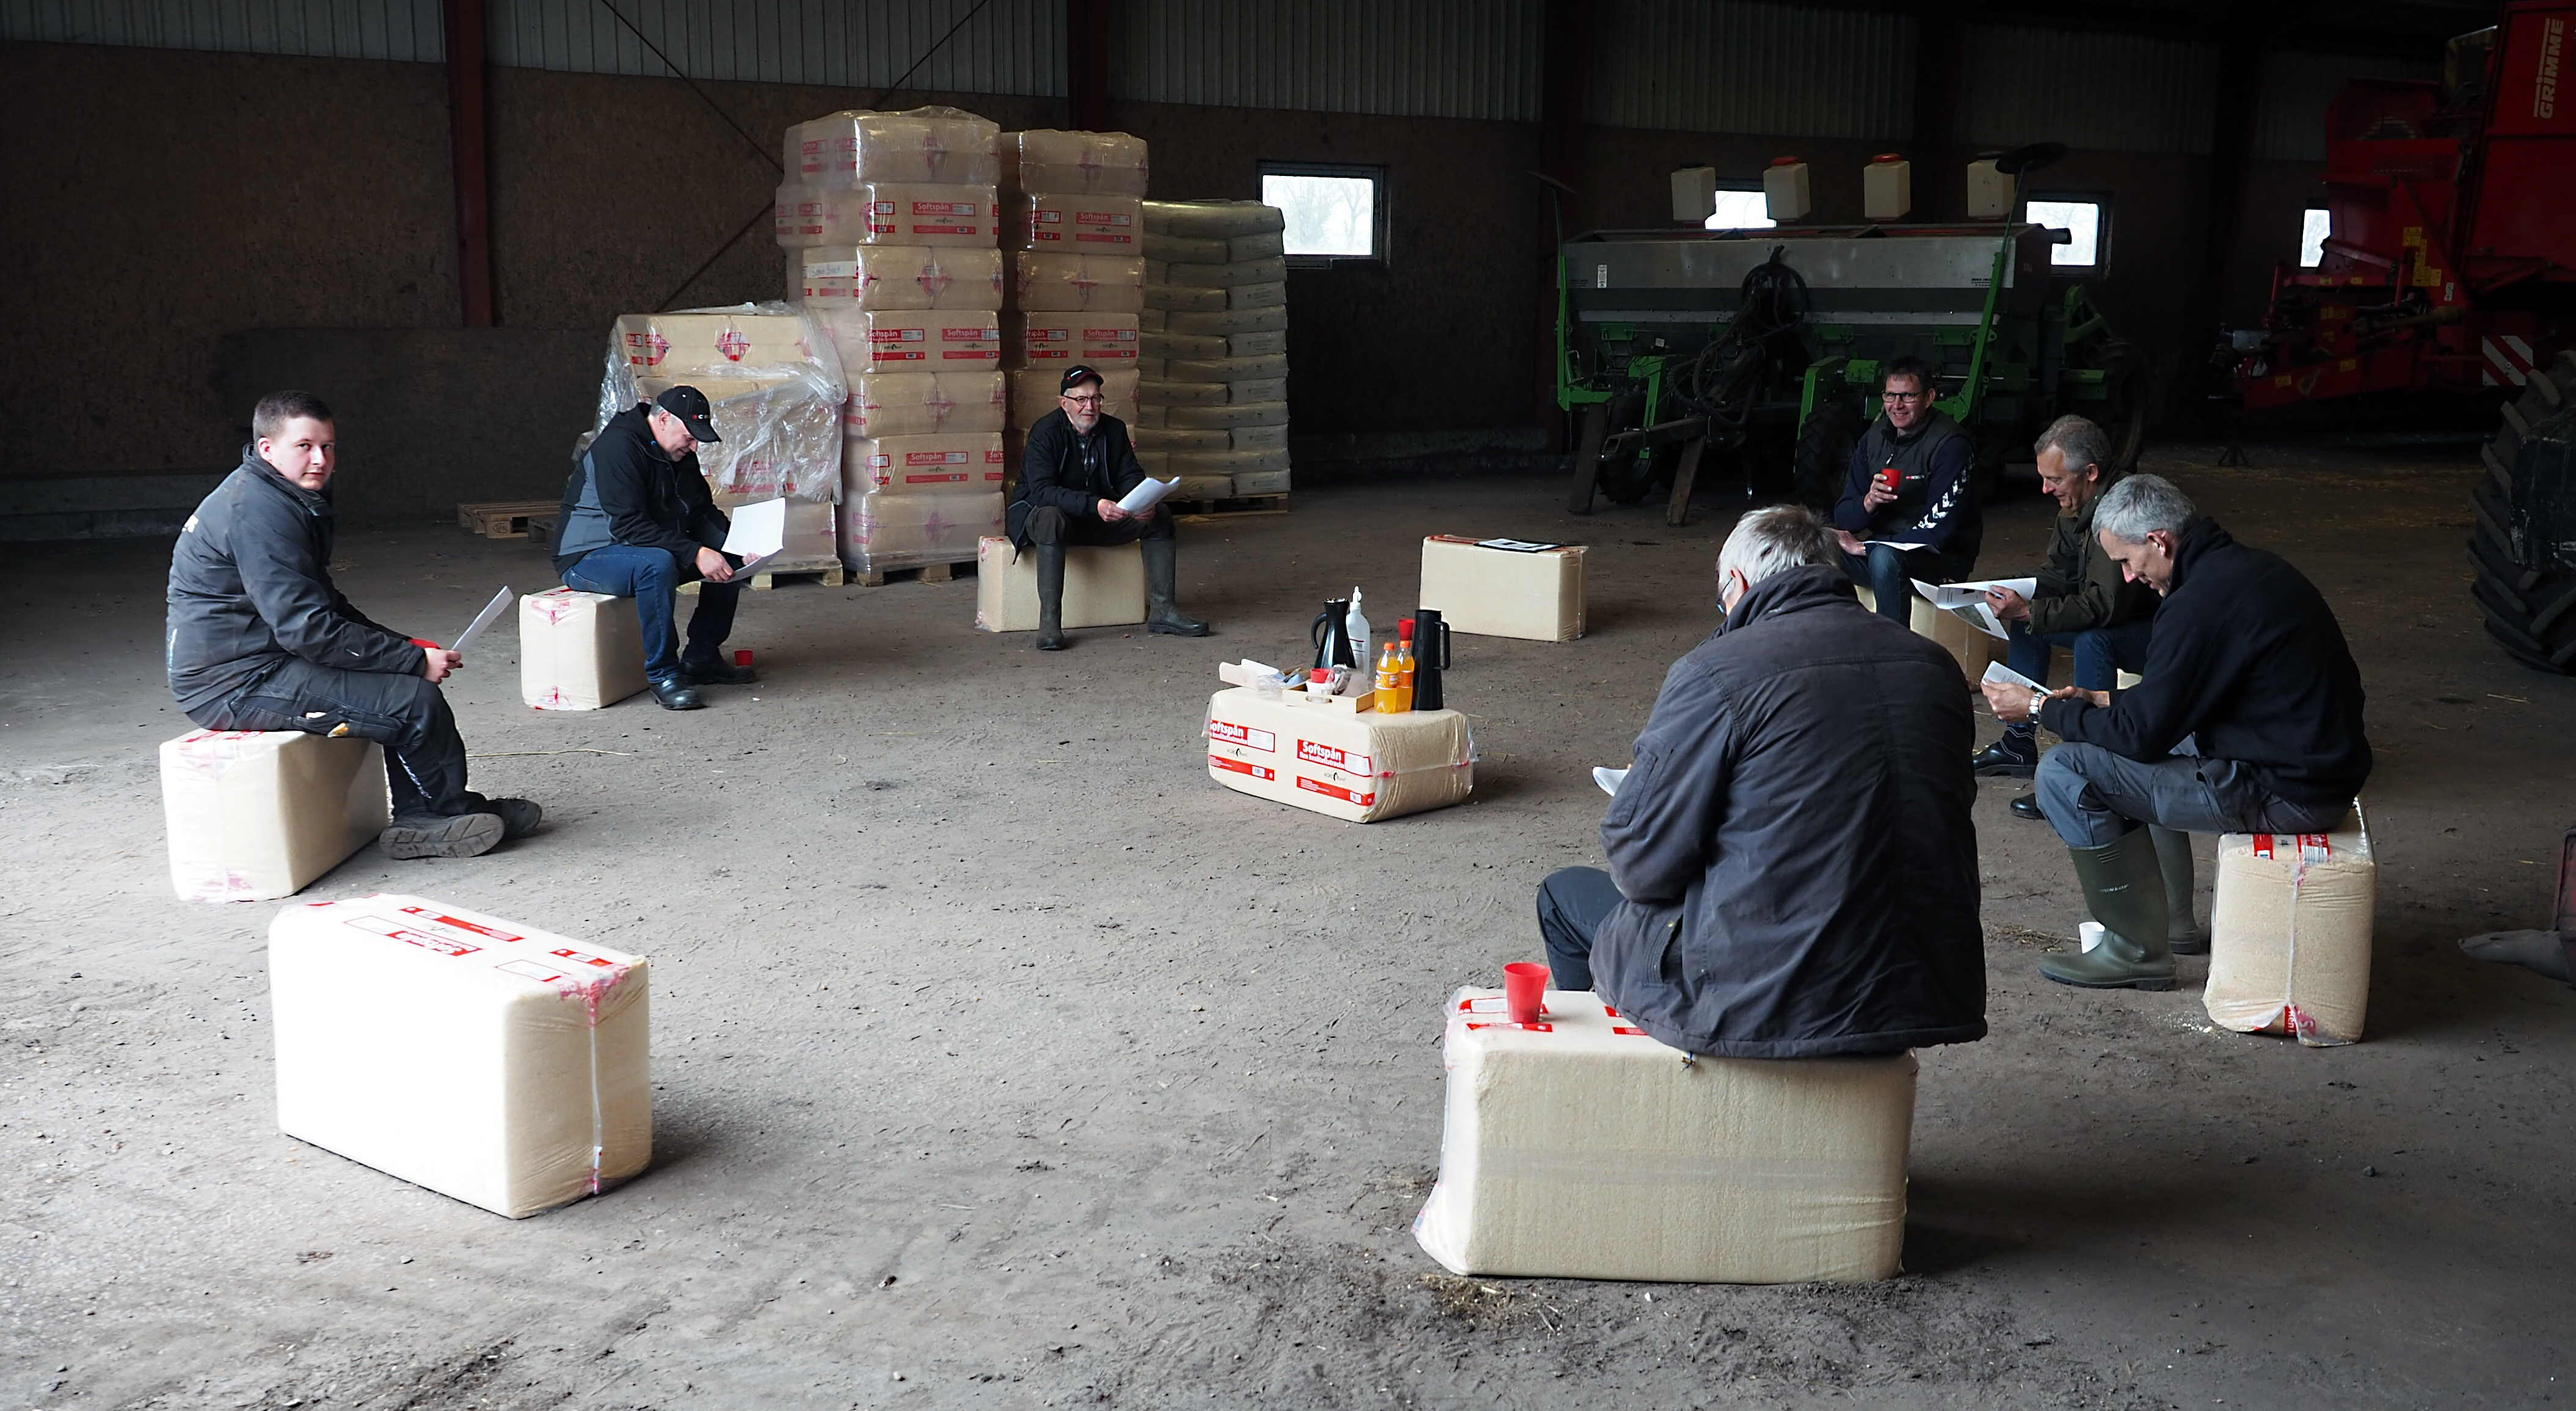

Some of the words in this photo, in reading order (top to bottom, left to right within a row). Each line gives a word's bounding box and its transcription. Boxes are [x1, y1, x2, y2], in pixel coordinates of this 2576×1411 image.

[2539, 19, 2564, 118] GRIMME
[917, 202, 949, 211] Softspån
[1080, 213, 1108, 221] Softspån
[911, 453, 942, 461] Softspån
[1302, 741, 1342, 762] Softspån
